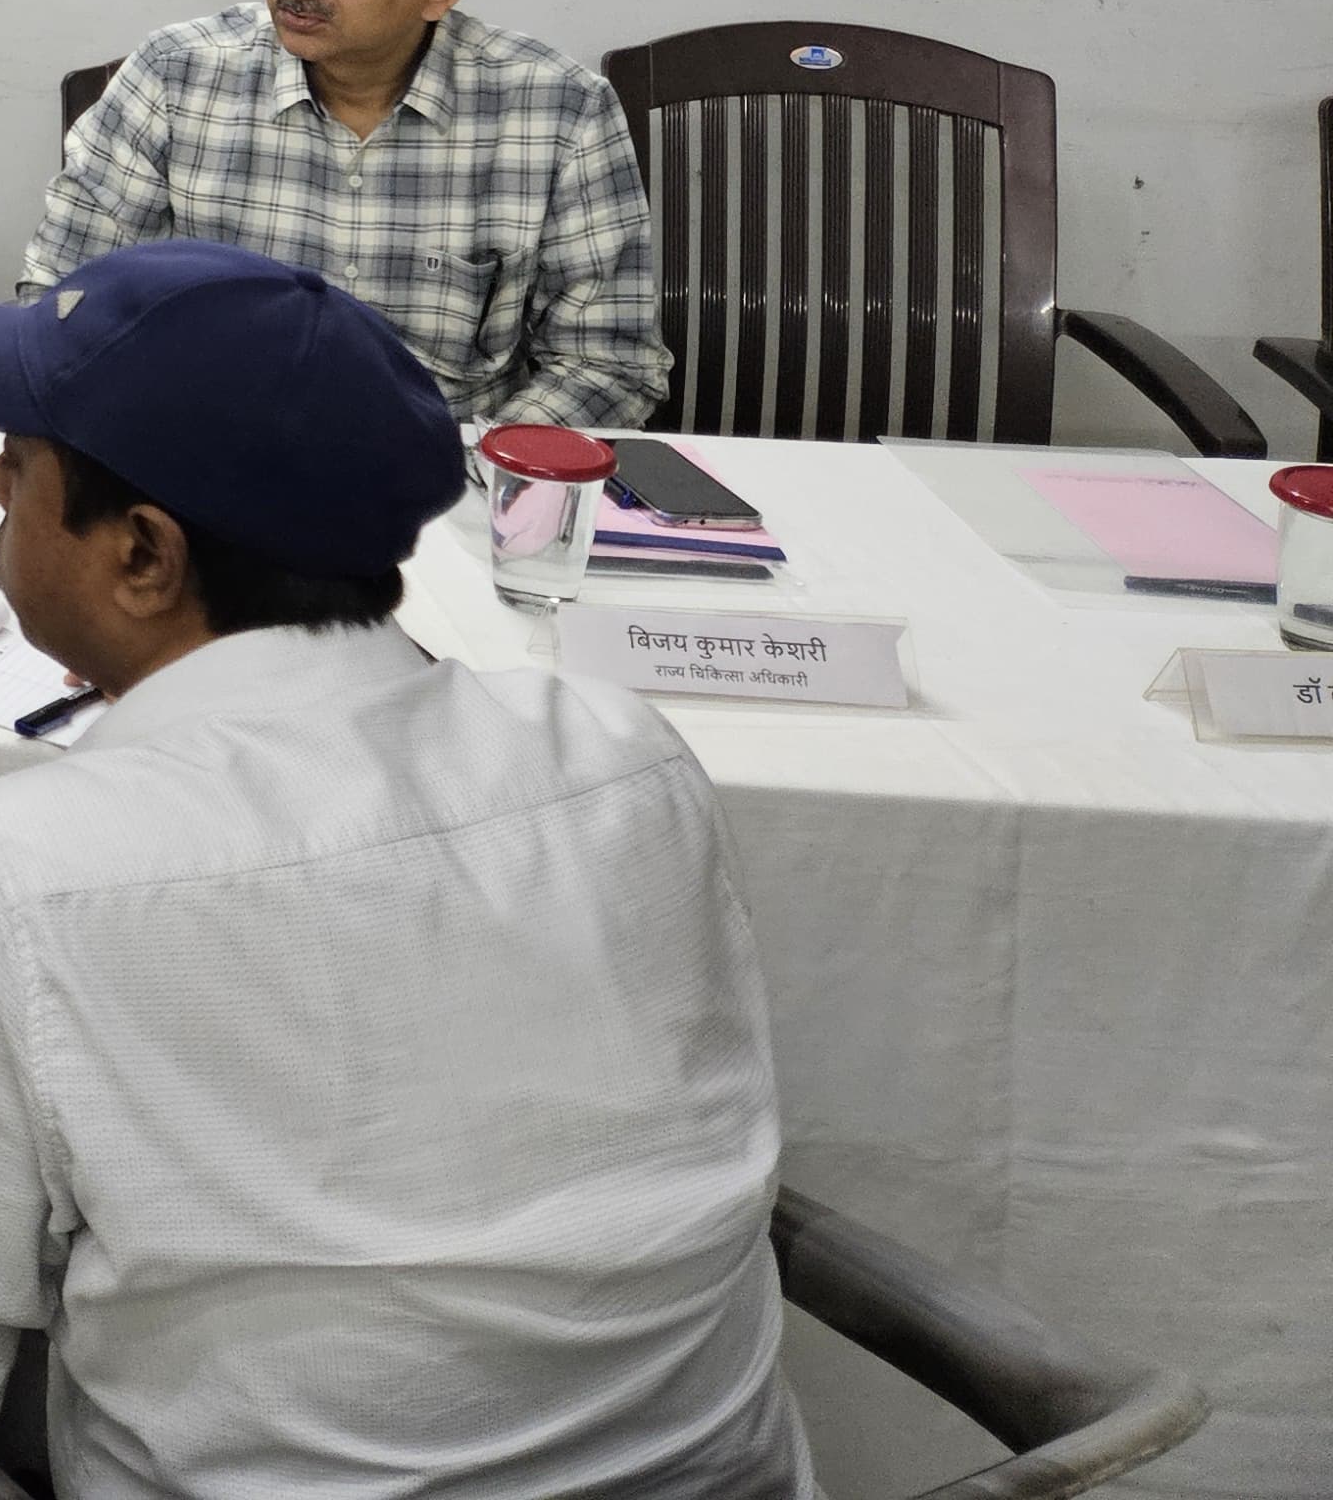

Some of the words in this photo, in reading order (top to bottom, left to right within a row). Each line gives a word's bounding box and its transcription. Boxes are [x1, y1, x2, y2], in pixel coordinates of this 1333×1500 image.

[627, 625, 687, 652] बिजय
[694, 636, 755, 659] कुमार
[761, 633, 827, 662] केशरी
[654, 665, 685, 678] राज्य
[690, 664, 743, 682] चिकित्सा
[749, 668, 808, 687] अधिकारी
[1293, 677, 1322, 704] डॉ
